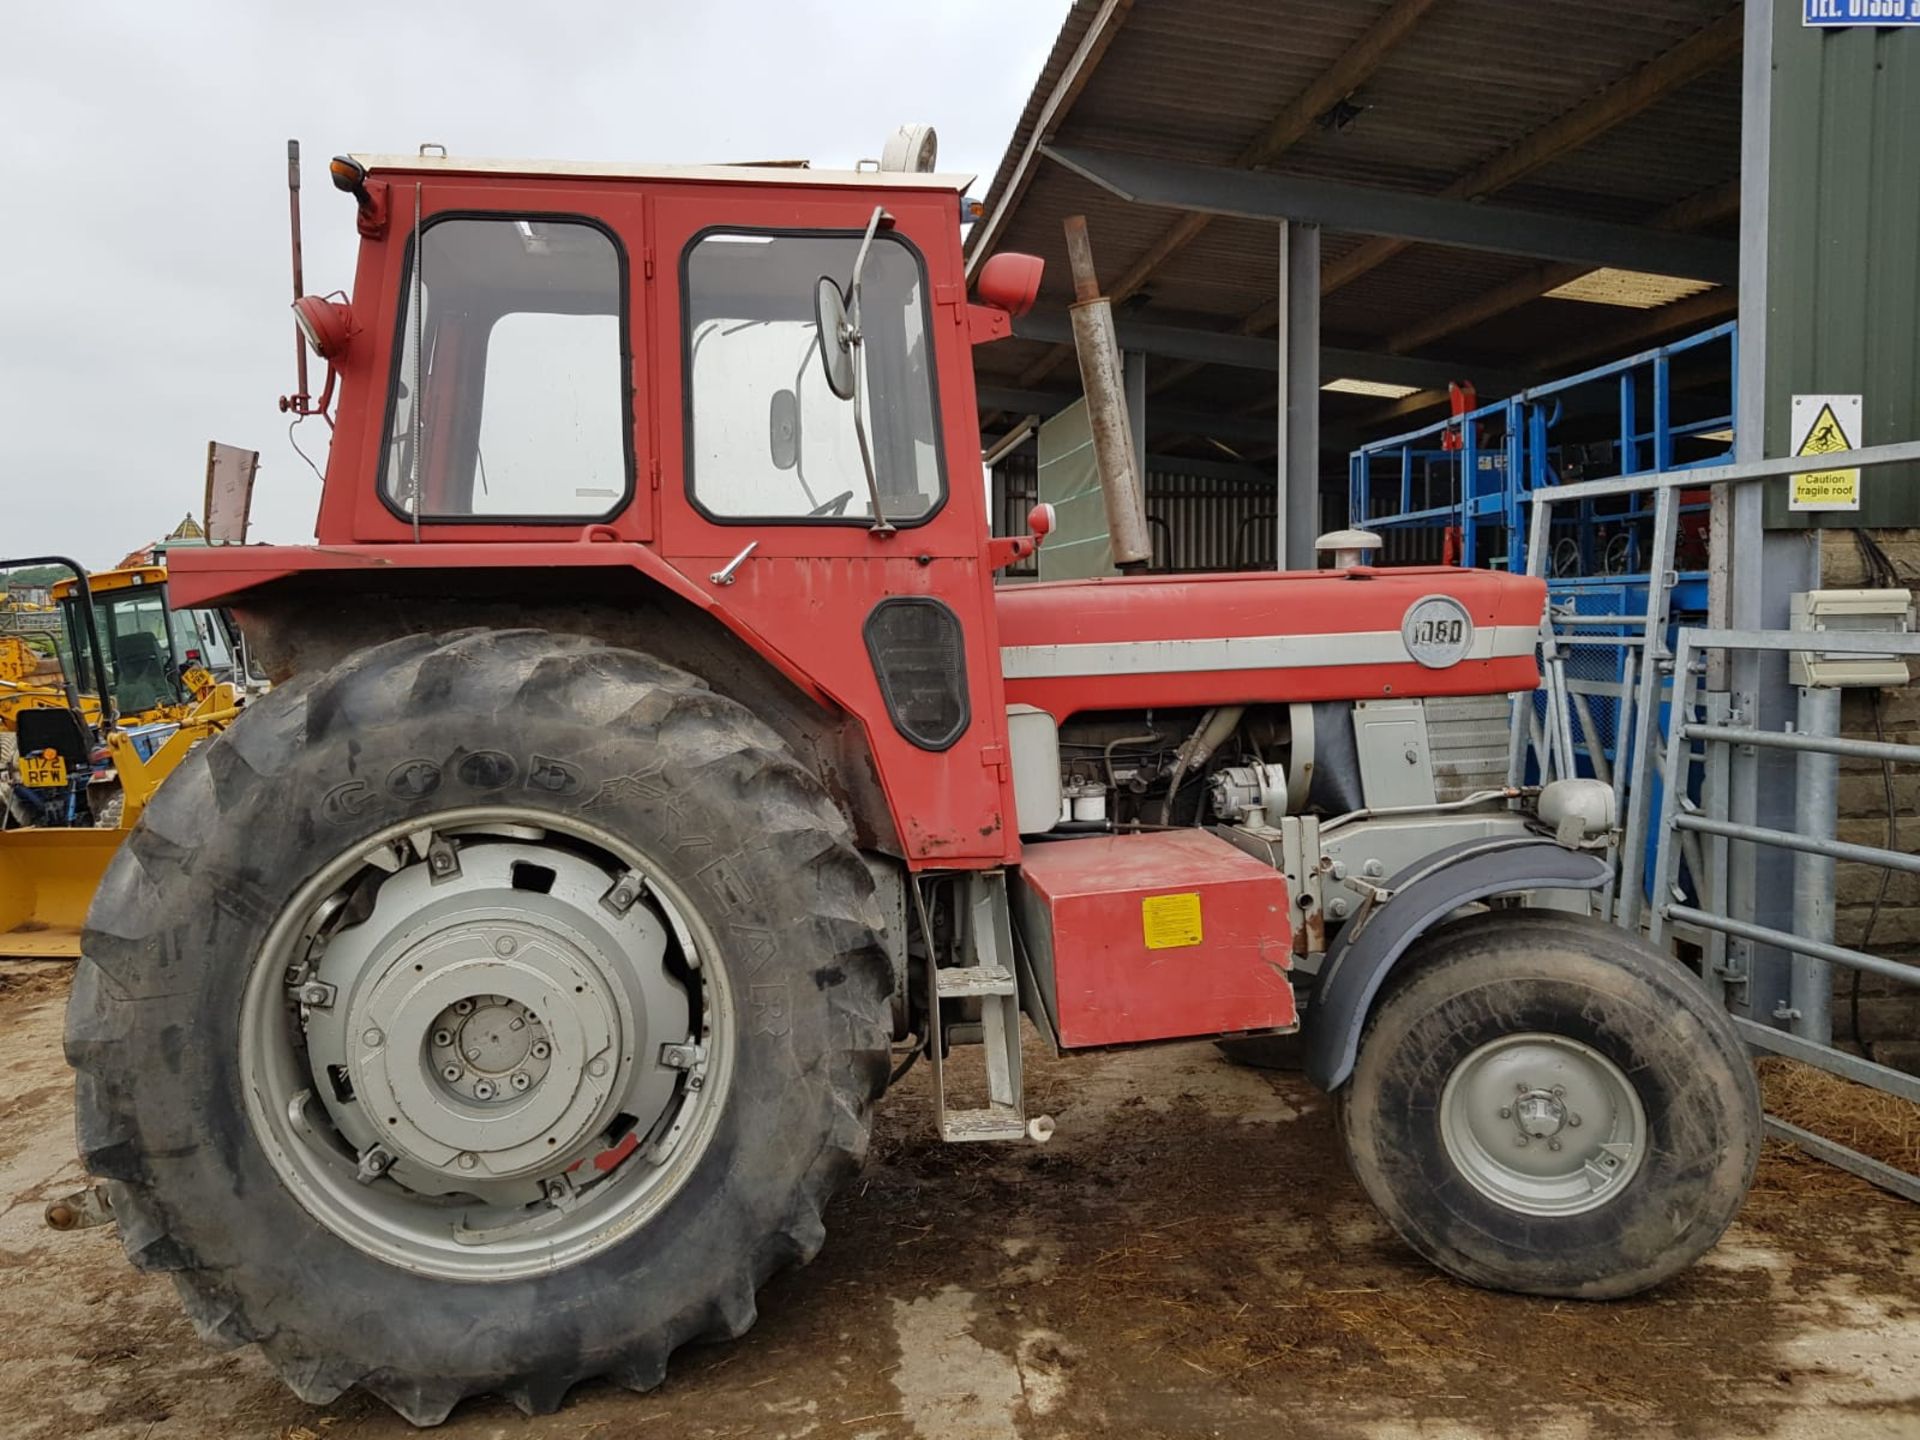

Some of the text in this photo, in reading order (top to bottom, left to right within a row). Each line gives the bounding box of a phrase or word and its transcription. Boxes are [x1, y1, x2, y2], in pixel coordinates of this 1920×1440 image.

[1805, 475, 1845, 484] Caution
[1797, 486, 1853, 497] fragile roof
[28, 770, 60, 783] RFW
